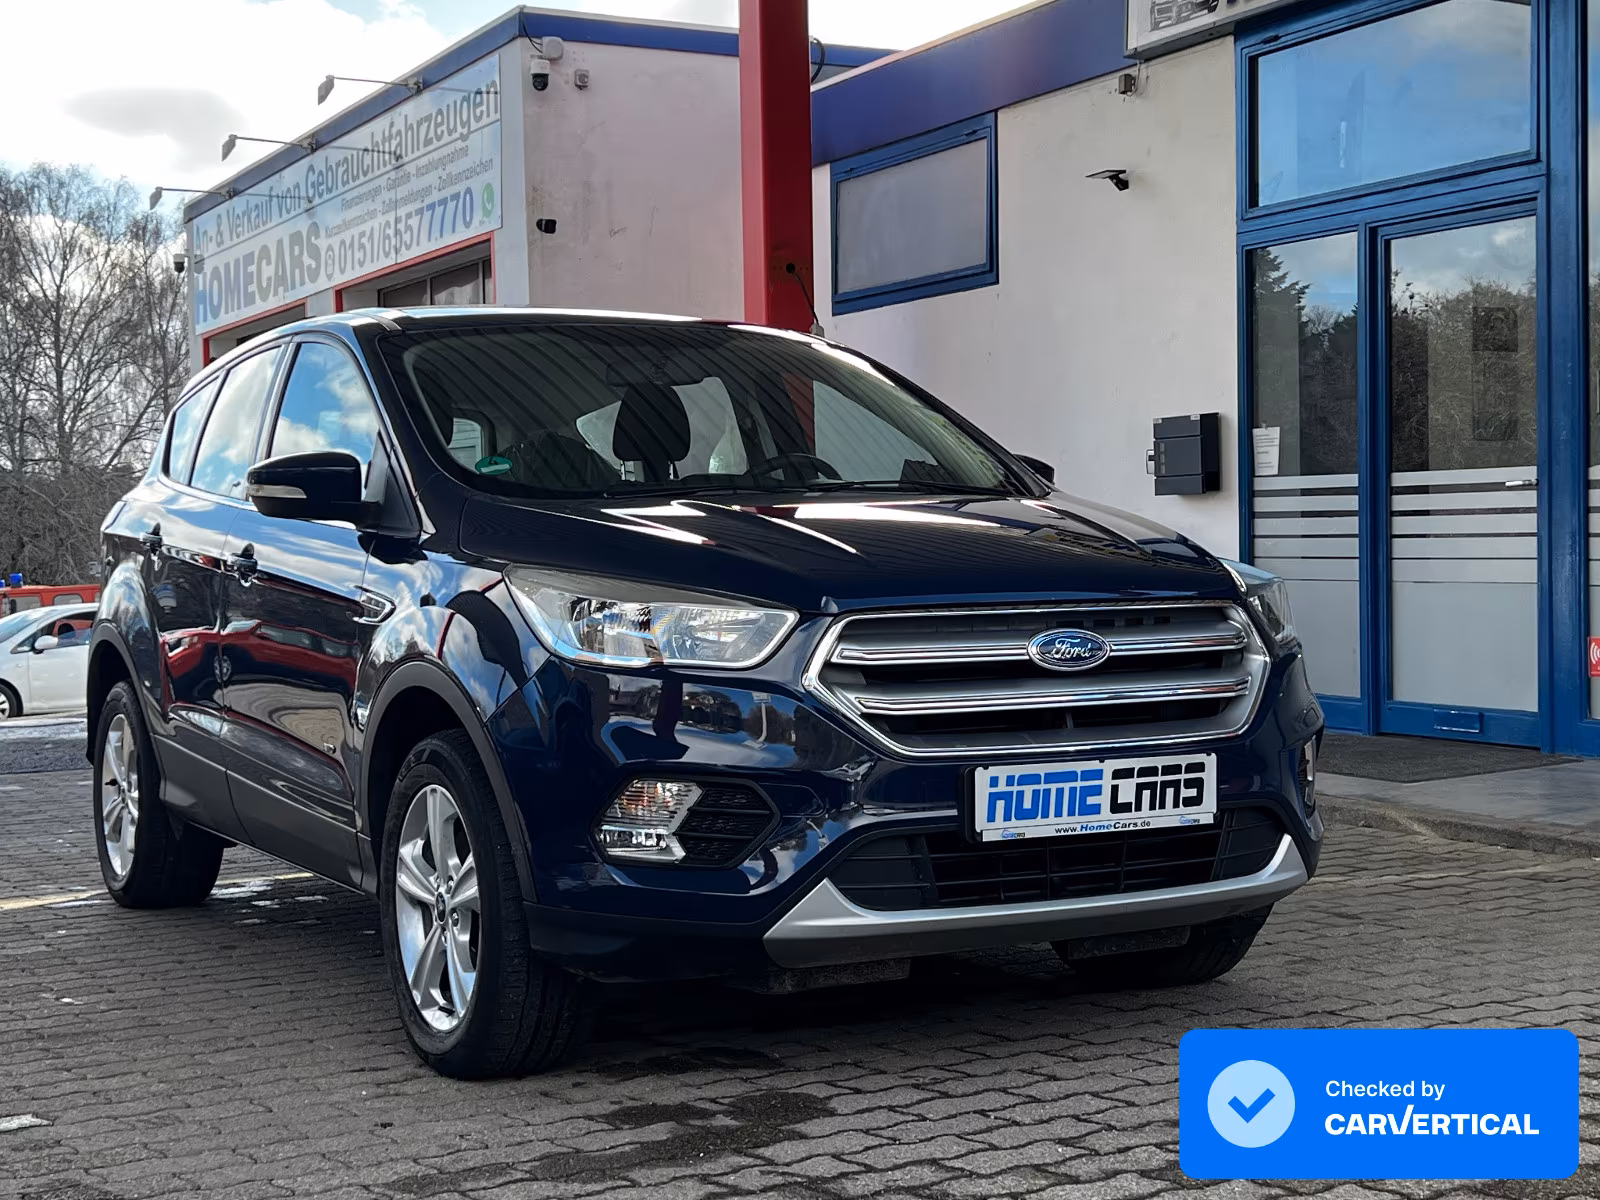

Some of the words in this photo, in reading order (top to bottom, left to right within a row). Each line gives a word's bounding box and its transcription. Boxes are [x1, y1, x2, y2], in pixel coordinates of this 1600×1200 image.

[215, 213, 224, 248] &
[226, 185, 274, 242] Verkauf
[276, 181, 301, 219] von
[305, 79, 499, 204] Gebrauchtfahrzeugen
[415, 144, 469, 179] Inzahlungnahme
[437, 157, 494, 193] Zollkennzeichen
[338, 187, 474, 275] 0151/65577770
[195, 221, 321, 325] HOMECARS
[1052, 638, 1092, 659] Ford
[986, 768, 1104, 824] HOME
[1109, 761, 1206, 815] CARS
[1054, 820, 1151, 835] www.HomeCars.de
